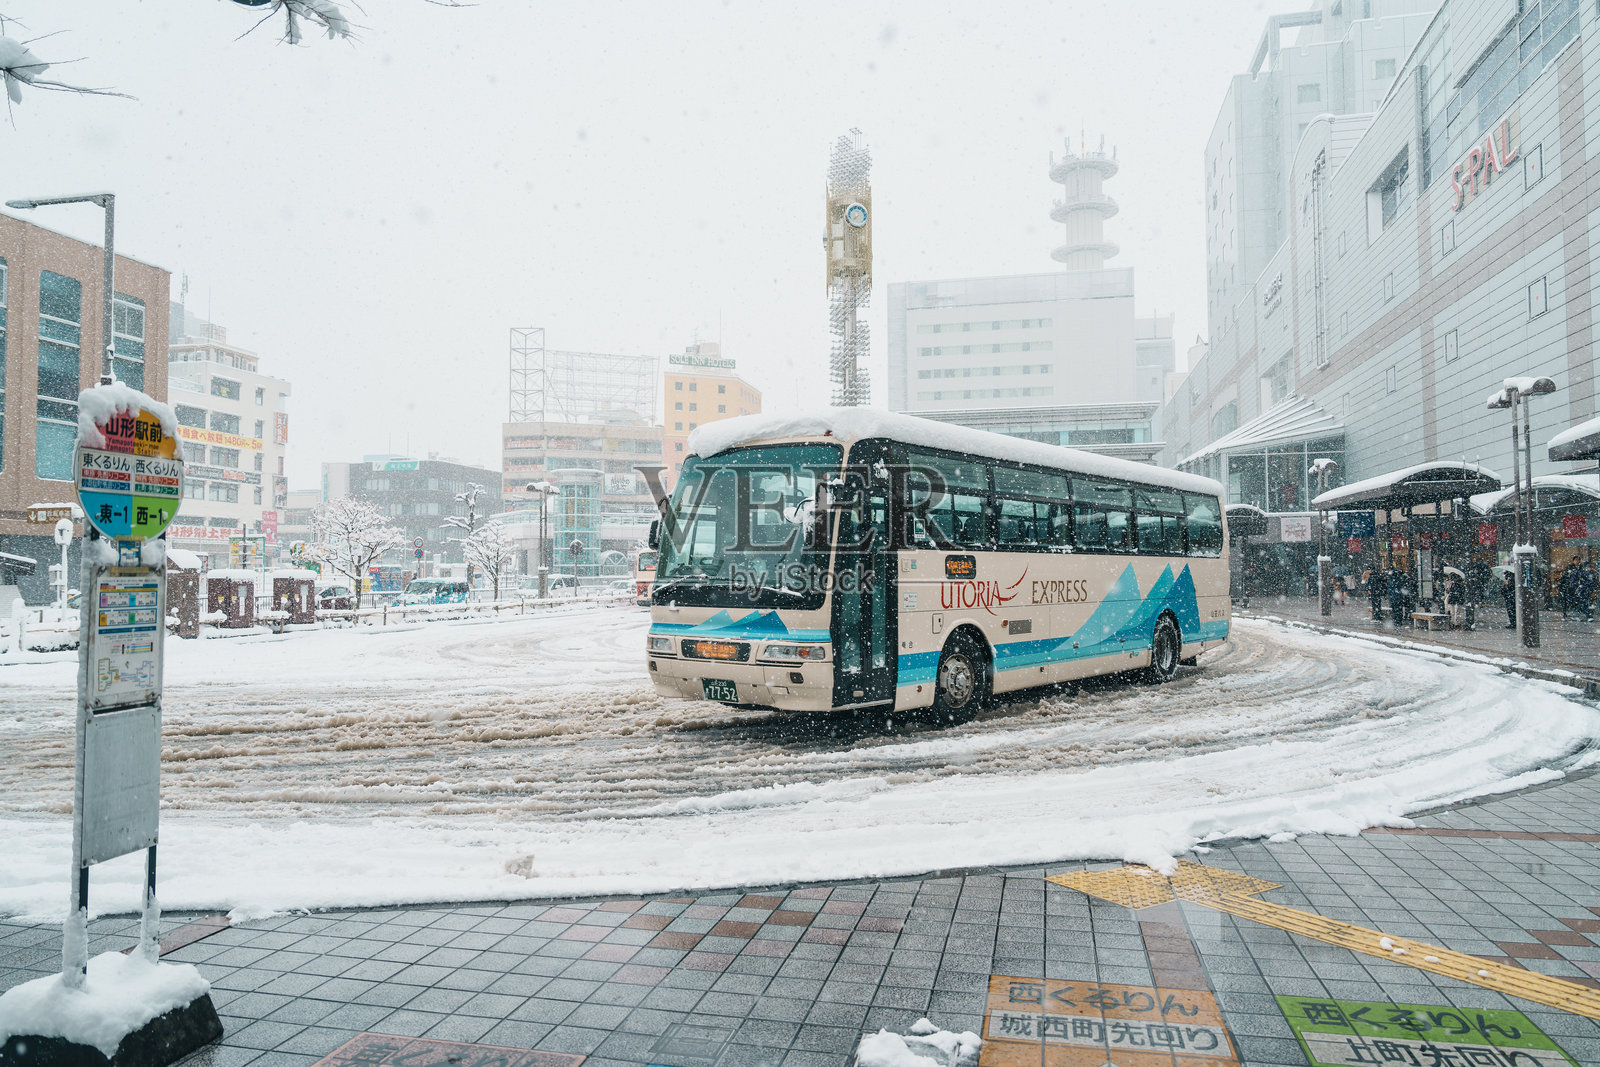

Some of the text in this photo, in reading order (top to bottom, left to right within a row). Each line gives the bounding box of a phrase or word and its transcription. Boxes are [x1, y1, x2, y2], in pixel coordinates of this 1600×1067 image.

[1452, 117, 1519, 211] S-PAL
[707, 358, 735, 369] HOTELS
[105, 417, 161, 442] 山形駅前
[83, 453, 131, 472] 東くるりん
[135, 459, 179, 477] 西くるりん
[100, 504, 127, 524] 東-1
[137, 507, 163, 526] 西-1
[941, 580, 1008, 616] UTORIA
[1032, 579, 1088, 604] EXPRESS
[1009, 981, 1199, 1017] 西くるりん
[1000, 1013, 1220, 1051] 城西町先回り
[1300, 1002, 1522, 1039] 西くるりん
[1345, 1038, 1544, 1067] 上町先回り
